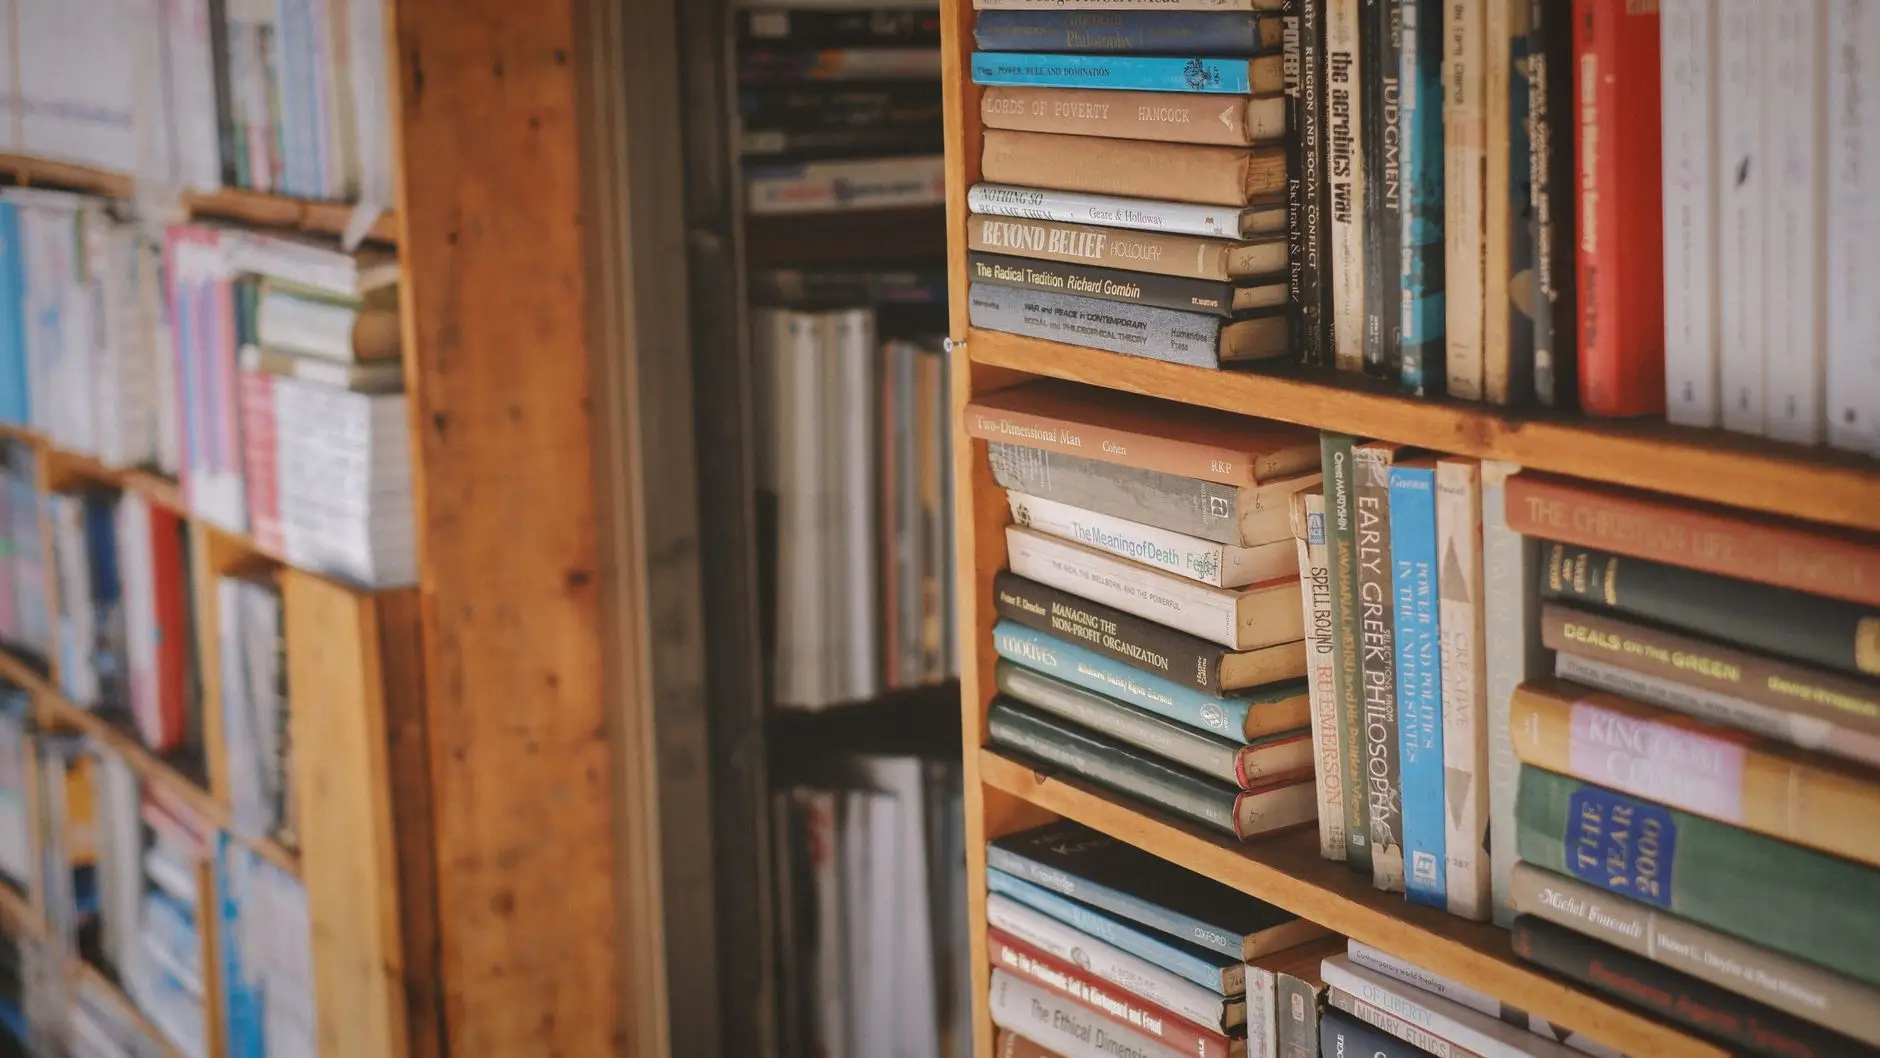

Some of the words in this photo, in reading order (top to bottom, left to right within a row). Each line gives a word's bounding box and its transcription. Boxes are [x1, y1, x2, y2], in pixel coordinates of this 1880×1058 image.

[1026, 65, 1045, 75] RULE
[1047, 67, 1061, 76] AND
[1064, 67, 1110, 77] DOMINATION
[1283, 16, 1300, 98] POVERTY
[1305, 47, 1314, 110] RELIGION
[1331, 52, 1352, 83] the
[985, 99, 1024, 115] LORDS
[1032, 101, 1047, 116] OF
[1055, 102, 1109, 120] POVERTY
[1138, 106, 1190, 123] HANCOCK
[1306, 115, 1315, 145] AND
[1332, 89, 1354, 177] aerobics
[1382, 76, 1399, 213] JUDGMENT
[1306, 151, 1316, 199] SOCIAL
[1028, 192, 1044, 206] SO
[1089, 208, 1113, 221] Geare
[1115, 210, 1123, 222] &
[1125, 211, 1163, 227] Holloway
[1290, 179, 1301, 240] Bachrach
[1334, 183, 1352, 225] way
[982, 221, 1046, 251] BEYOND
[1048, 229, 1107, 259] BELIEF
[1110, 241, 1162, 261] HOLLOWAY
[1291, 244, 1300, 254] &
[1308, 205, 1317, 270] CONFLICT
[976, 262, 992, 278] The
[994, 265, 1024, 283] Radical
[1027, 268, 1063, 288] Tradition
[1067, 272, 1101, 293] Richard
[1103, 280, 1141, 299] Gombin
[1291, 262, 1301, 302] Baratz
[1041, 305, 1053, 314] and
[1055, 308, 1078, 319] PEACE
[1087, 313, 1148, 330] CONTEMPORARY
[1117, 332, 1148, 345] THEORY
[976, 414, 1056, 442] Two-Dimensional
[1060, 430, 1081, 447] Man
[1102, 440, 1126, 455] Cohen
[1211, 461, 1232, 474] RKP
[1525, 497, 1567, 528] THE
[1072, 521, 1092, 542] The
[1148, 542, 1180, 565] Death
[1359, 496, 1381, 575] EARLY
[1399, 560, 1413, 579] IN
[1137, 588, 1148, 600] THE
[1149, 593, 1181, 611] POWERFUL
[1400, 586, 1414, 620] THE
[1416, 561, 1430, 624] POWER
[1052, 602, 1098, 628] MANAGING
[1100, 619, 1117, 635] THE
[1362, 581, 1385, 661] GREEK
[1052, 616, 1101, 644] NON-PROFIT
[1103, 635, 1169, 670] ORGANIZATION
[1383, 629, 1392, 691] SELECTIONS
[1402, 627, 1417, 695] UNITED
[1417, 631, 1432, 665] AND
[1564, 623, 1620, 650] DEALS
[1671, 650, 1740, 681] GREEN
[1454, 632, 1470, 729] CREATIVE
[1385, 693, 1394, 722] FROM
[1418, 672, 1434, 749] POLITICS
[1318, 697, 1342, 806] EMERSON
[1366, 670, 1390, 829] PHILOSOPHY
[1405, 700, 1419, 763] STATES
[1578, 801, 1602, 868] THE
[1607, 805, 1634, 887] YEAR
[1635, 818, 1661, 897] 2000
[1539, 888, 1584, 916] Michel
[1589, 905, 1642, 938] Foucault
[1194, 927, 1228, 947] OXFORD
[1031, 998, 1050, 1024] The
[1052, 1010, 1093, 1044] Ethical
[1142, 1010, 1162, 1036] Freud
[1363, 984, 1379, 1002] OF
[1383, 993, 1432, 1026] LIBERTY
[1356, 1000, 1399, 1036] MILITARY
[1406, 1027, 1447, 1058] ETHICS
